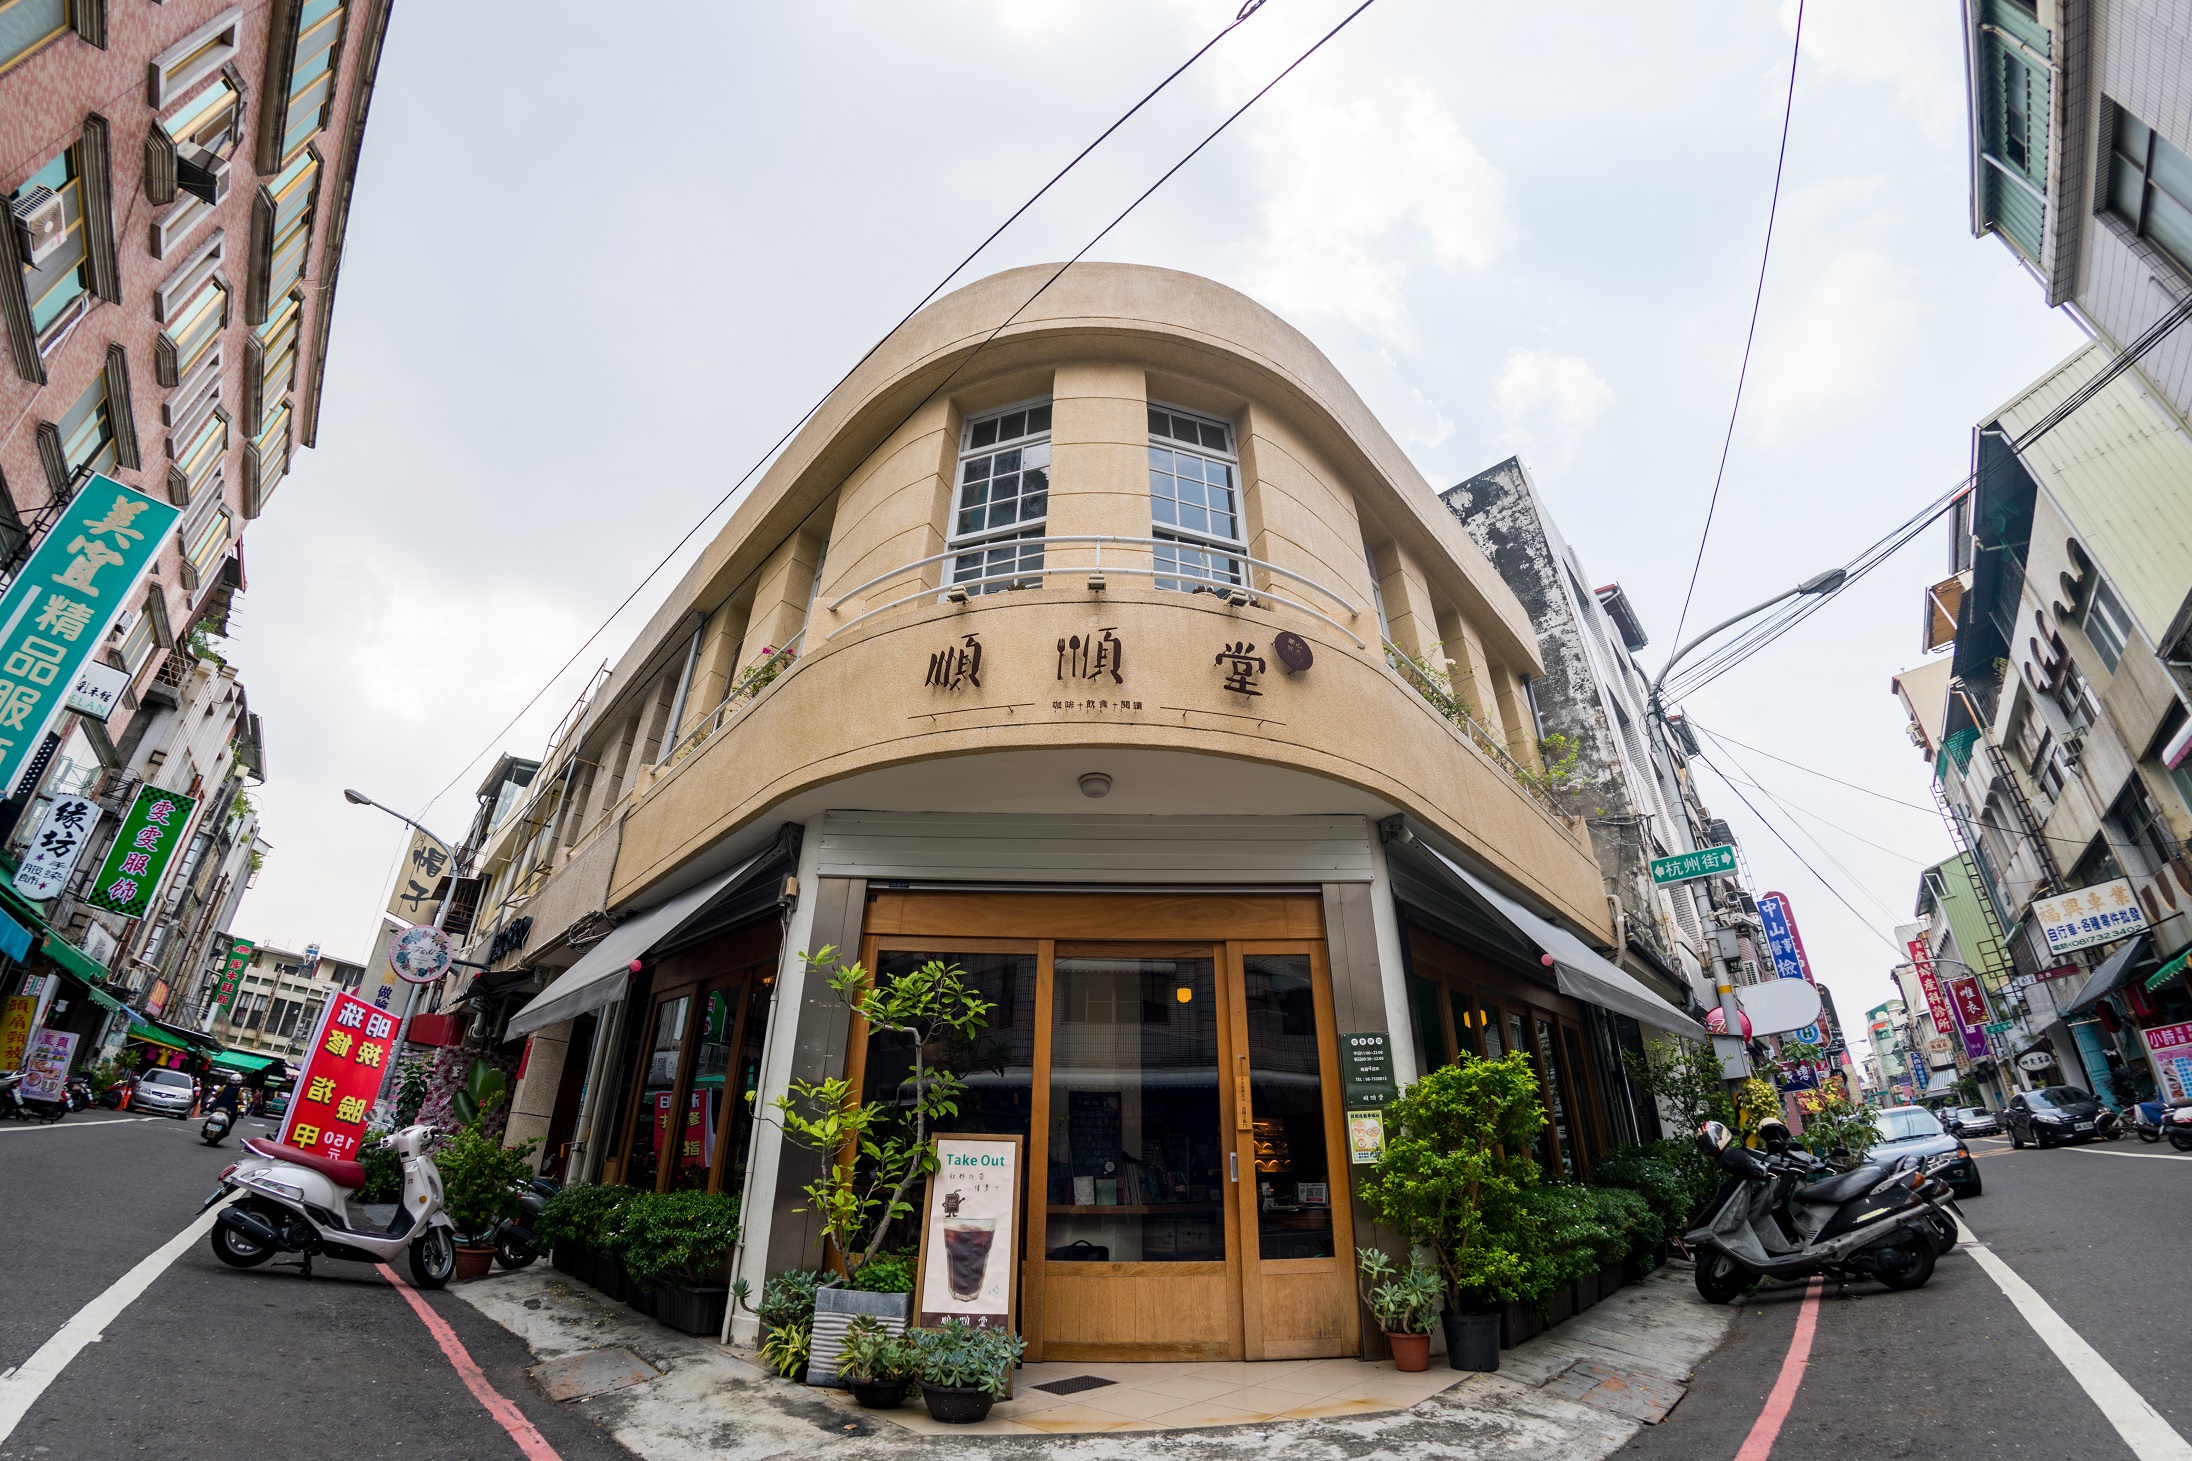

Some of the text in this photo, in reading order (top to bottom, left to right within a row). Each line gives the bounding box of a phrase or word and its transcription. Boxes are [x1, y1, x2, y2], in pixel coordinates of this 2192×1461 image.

[925, 627, 1266, 699] 順順堂
[108, 800, 176, 904] 雯雯服飾
[1665, 853, 1719, 877] 杭州街
[2038, 885, 2130, 923] 福興車業
[216, 959, 243, 1005] 犀牛鞋館
[1960, 986, 1981, 1014] 唯衣
[2149, 1029, 2176, 1047] 小詩
[947, 1154, 1005, 1167] Take Out
